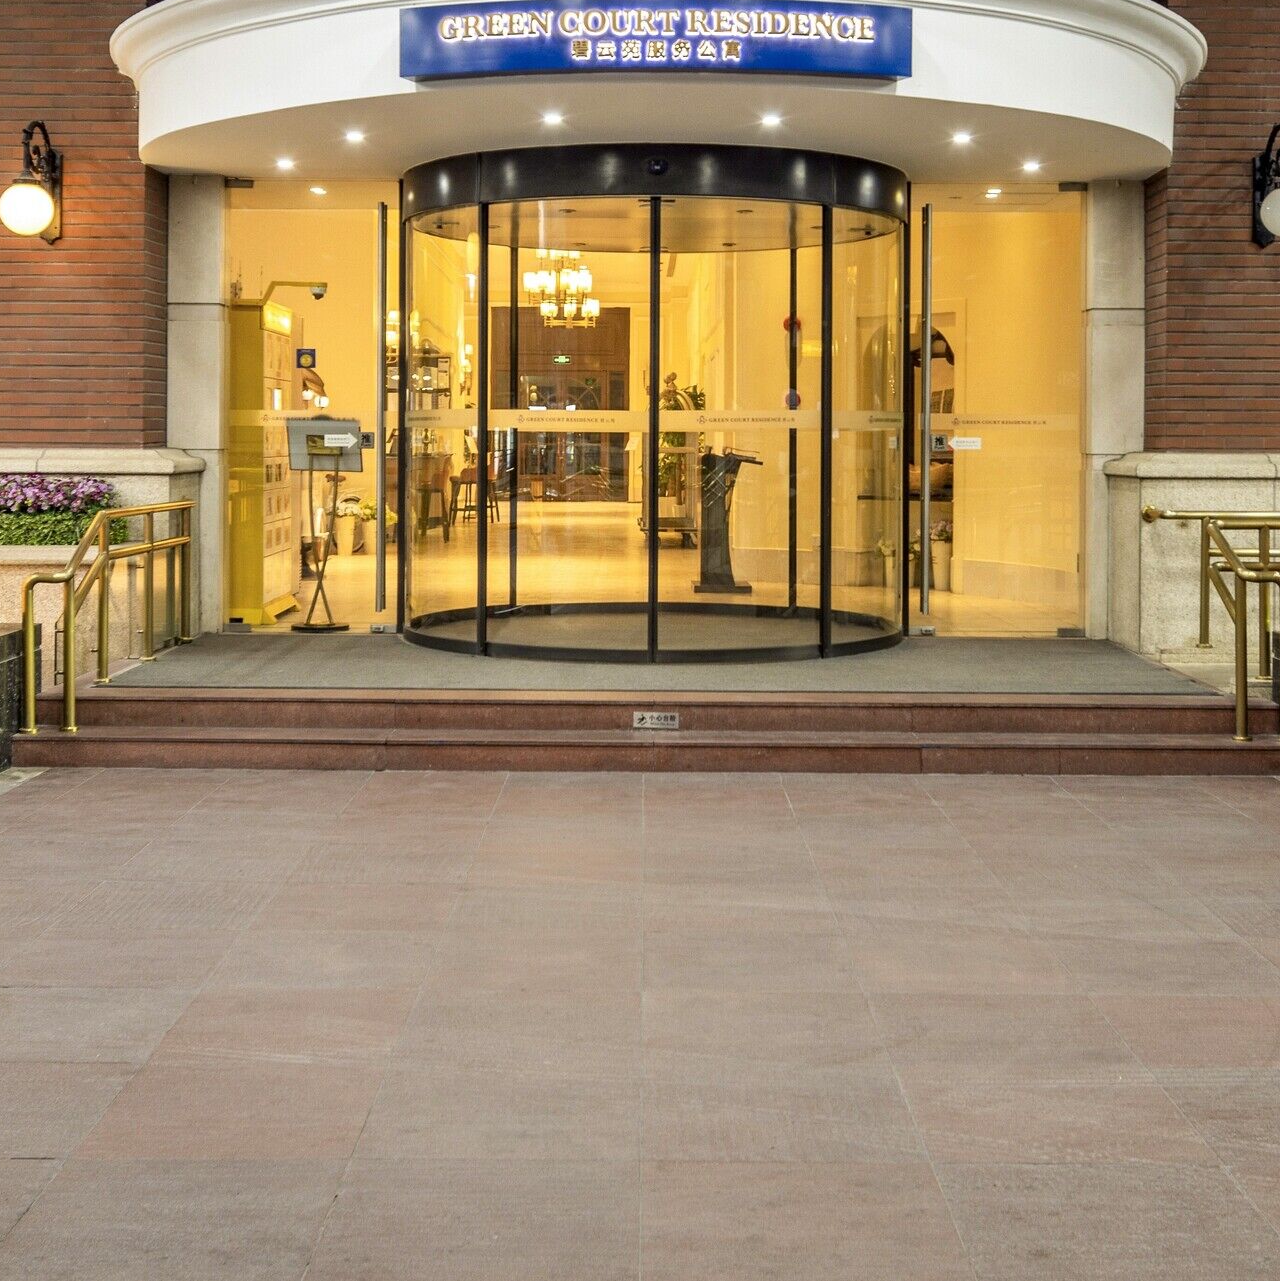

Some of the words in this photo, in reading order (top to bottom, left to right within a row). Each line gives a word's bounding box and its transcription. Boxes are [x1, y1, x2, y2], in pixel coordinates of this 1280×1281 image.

[439, 10, 553, 42] GREEN
[558, 8, 680, 37] COURT
[685, 9, 876, 42] RESIDENCE
